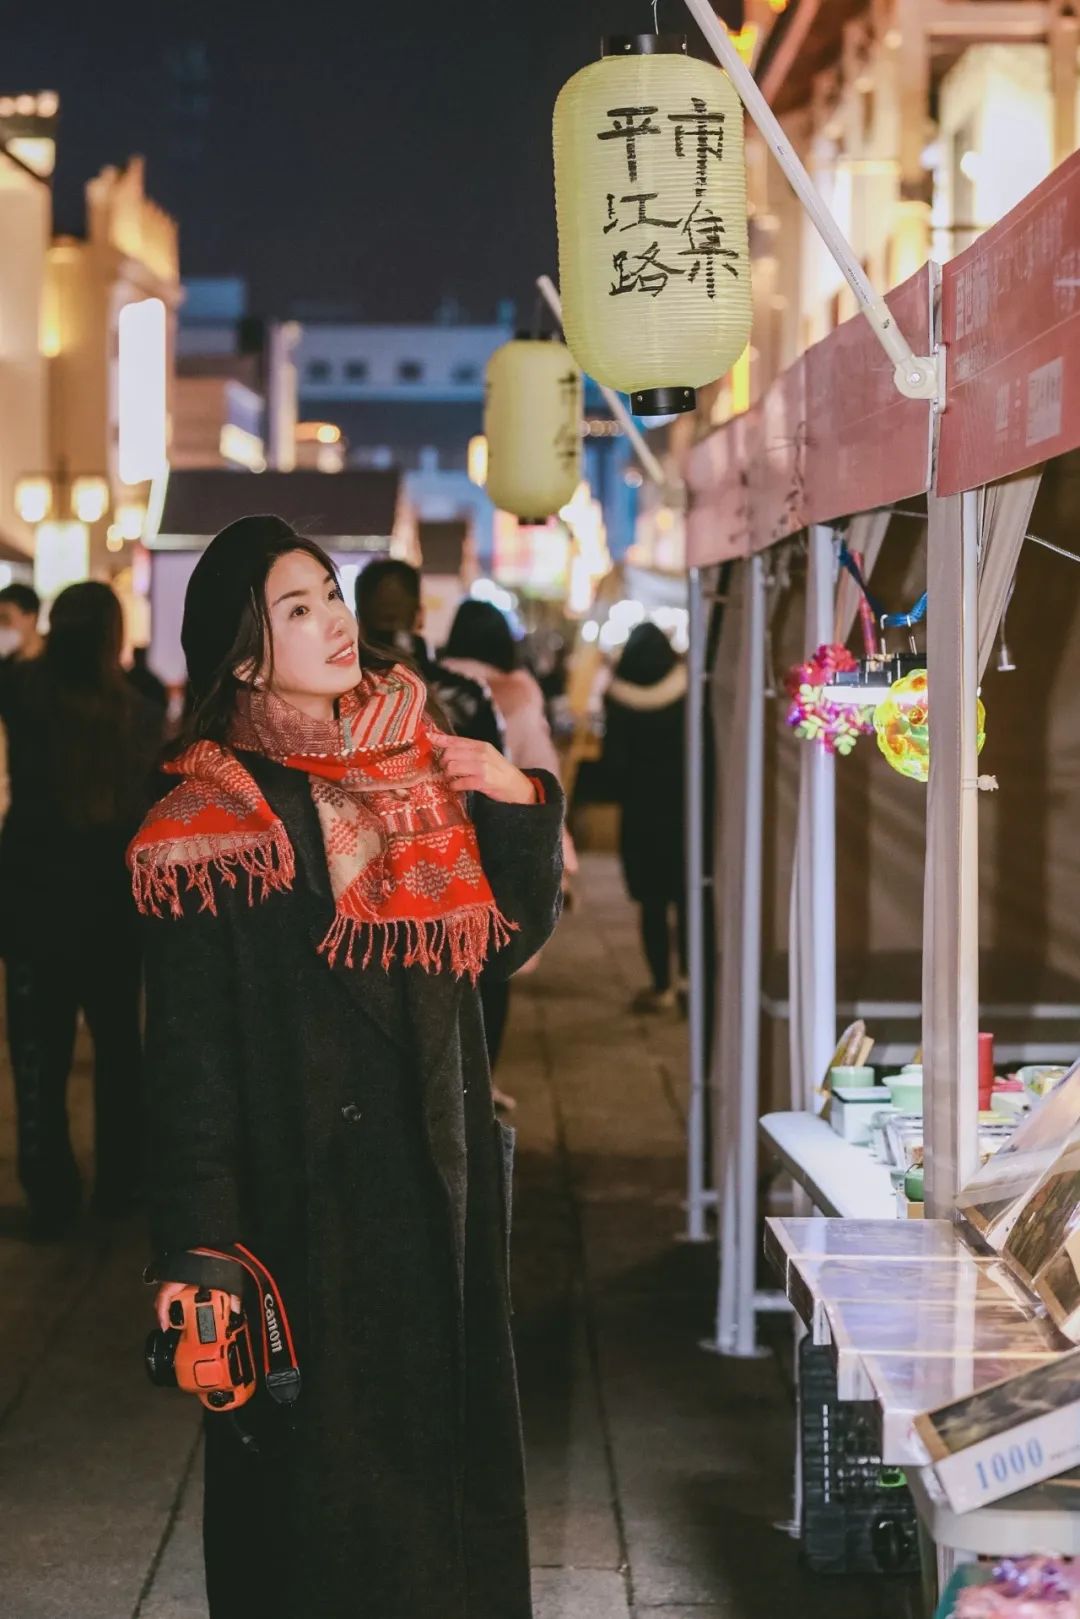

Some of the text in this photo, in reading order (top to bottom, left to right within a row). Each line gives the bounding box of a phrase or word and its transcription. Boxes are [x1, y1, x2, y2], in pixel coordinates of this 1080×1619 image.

[597, 106, 685, 297] 平江路
[668, 97, 739, 299] 市集
[264, 1294, 283, 1353] Canon
[976, 1437, 1043, 1489] 1000
